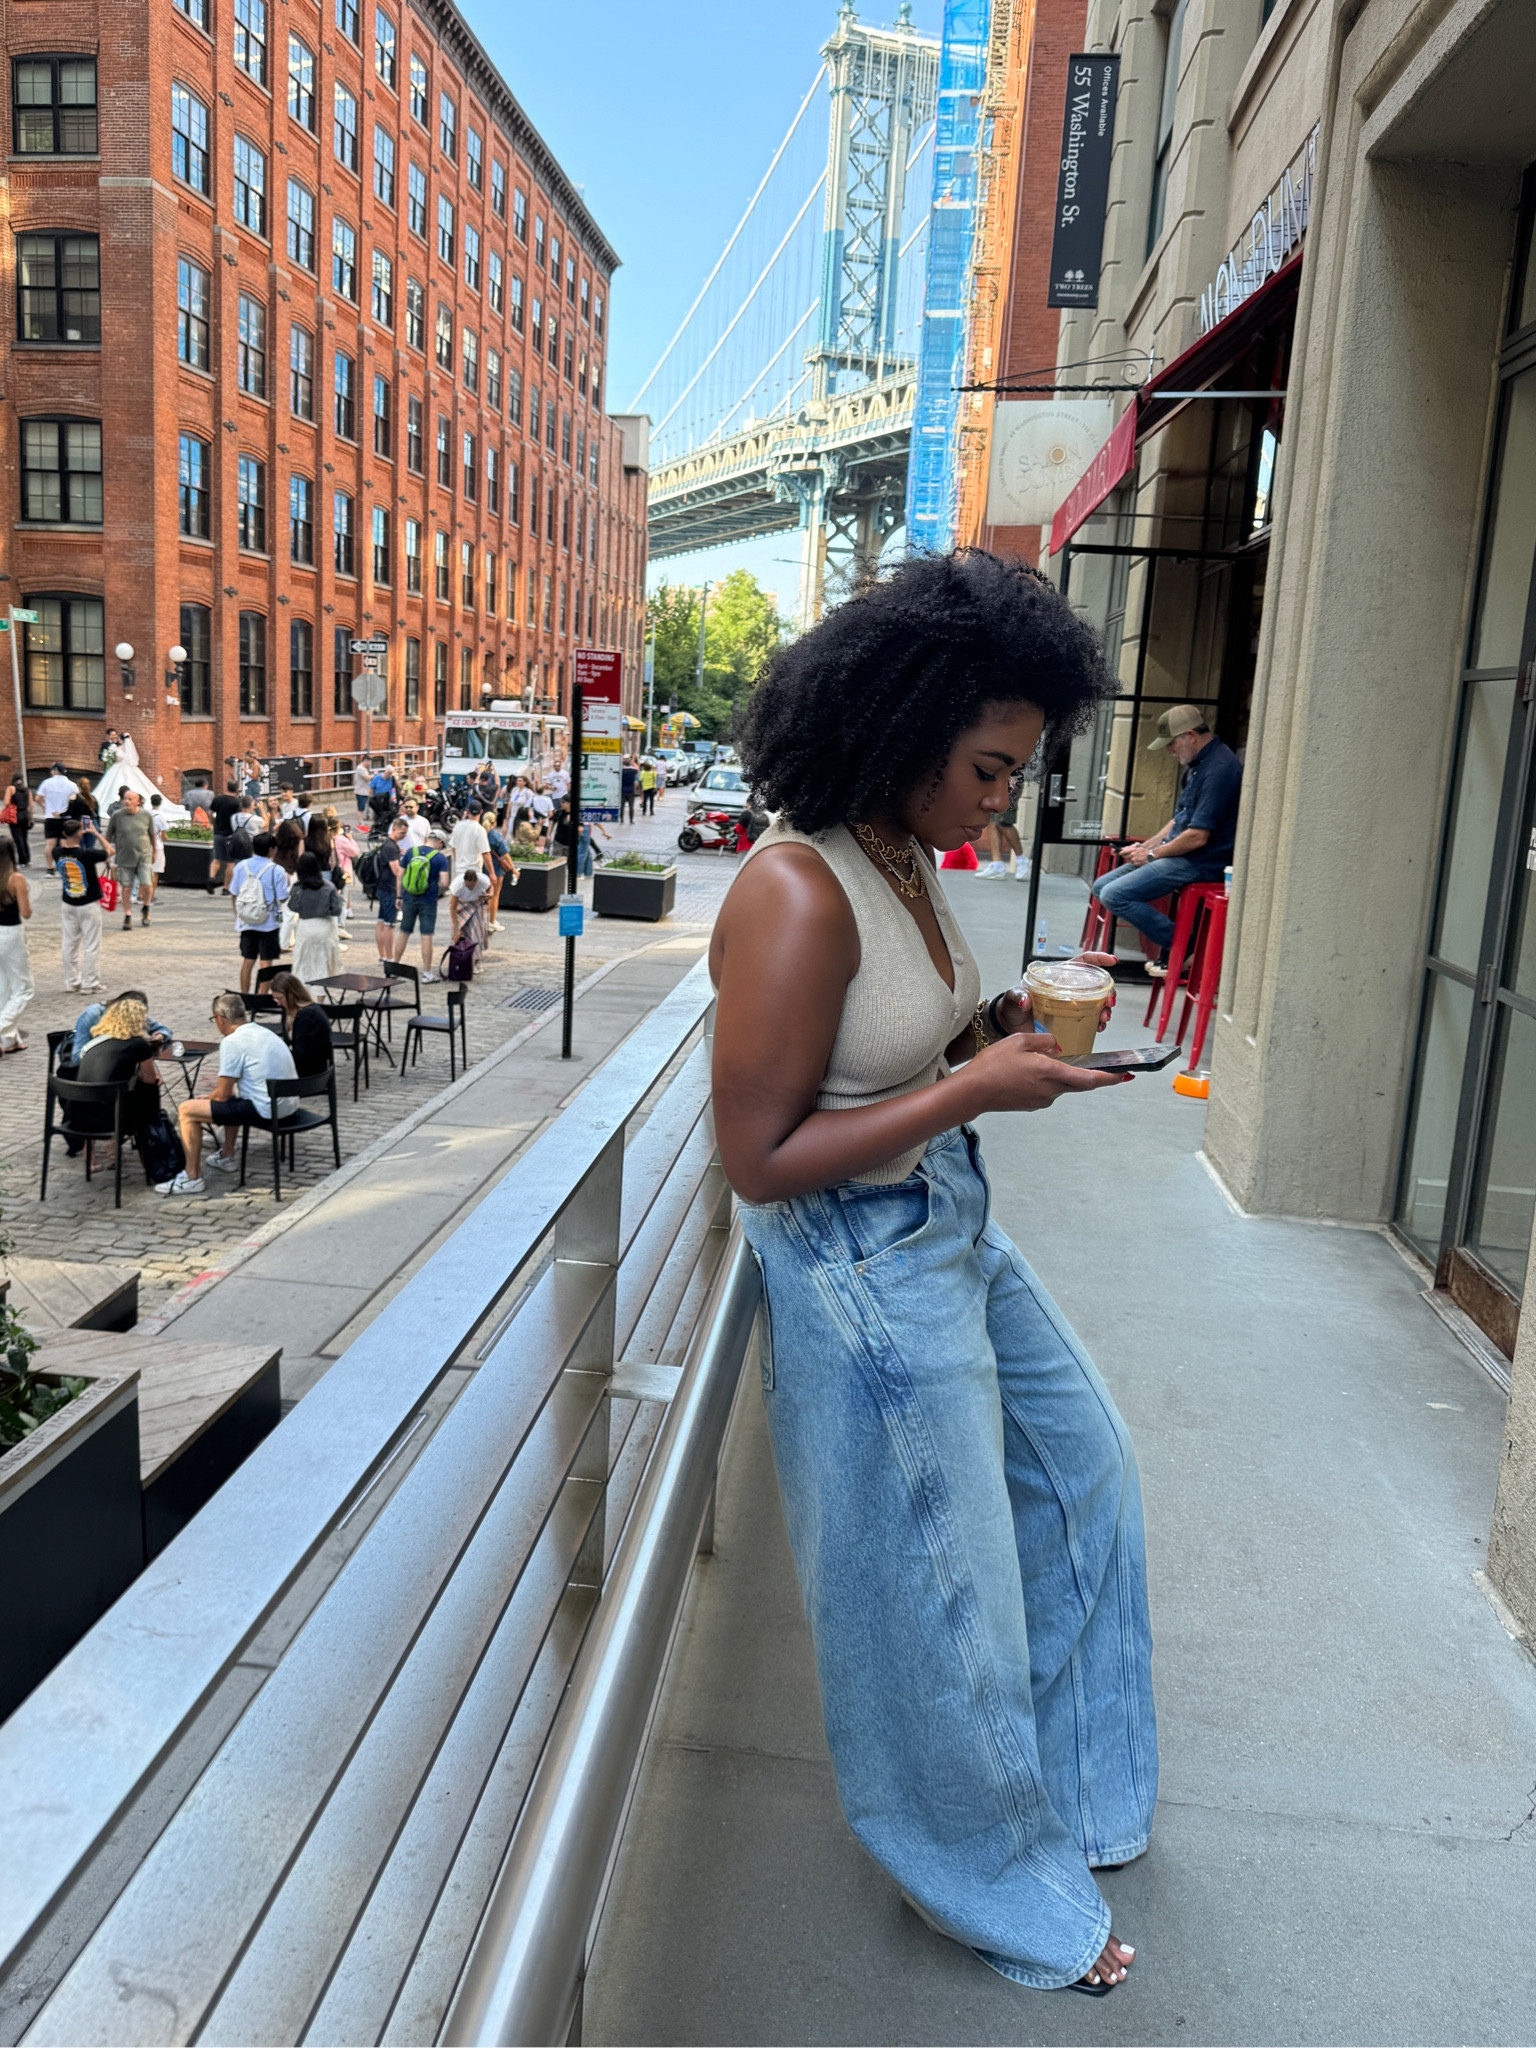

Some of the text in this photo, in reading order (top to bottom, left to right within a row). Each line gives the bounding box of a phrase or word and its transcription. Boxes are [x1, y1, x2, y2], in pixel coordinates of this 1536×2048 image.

[1097, 65, 1112, 137] Offices Available
[1061, 65, 1092, 228] 55 Washington St.
[1071, 283, 1094, 291] TREES
[577, 652, 615, 662] NO STANDING
